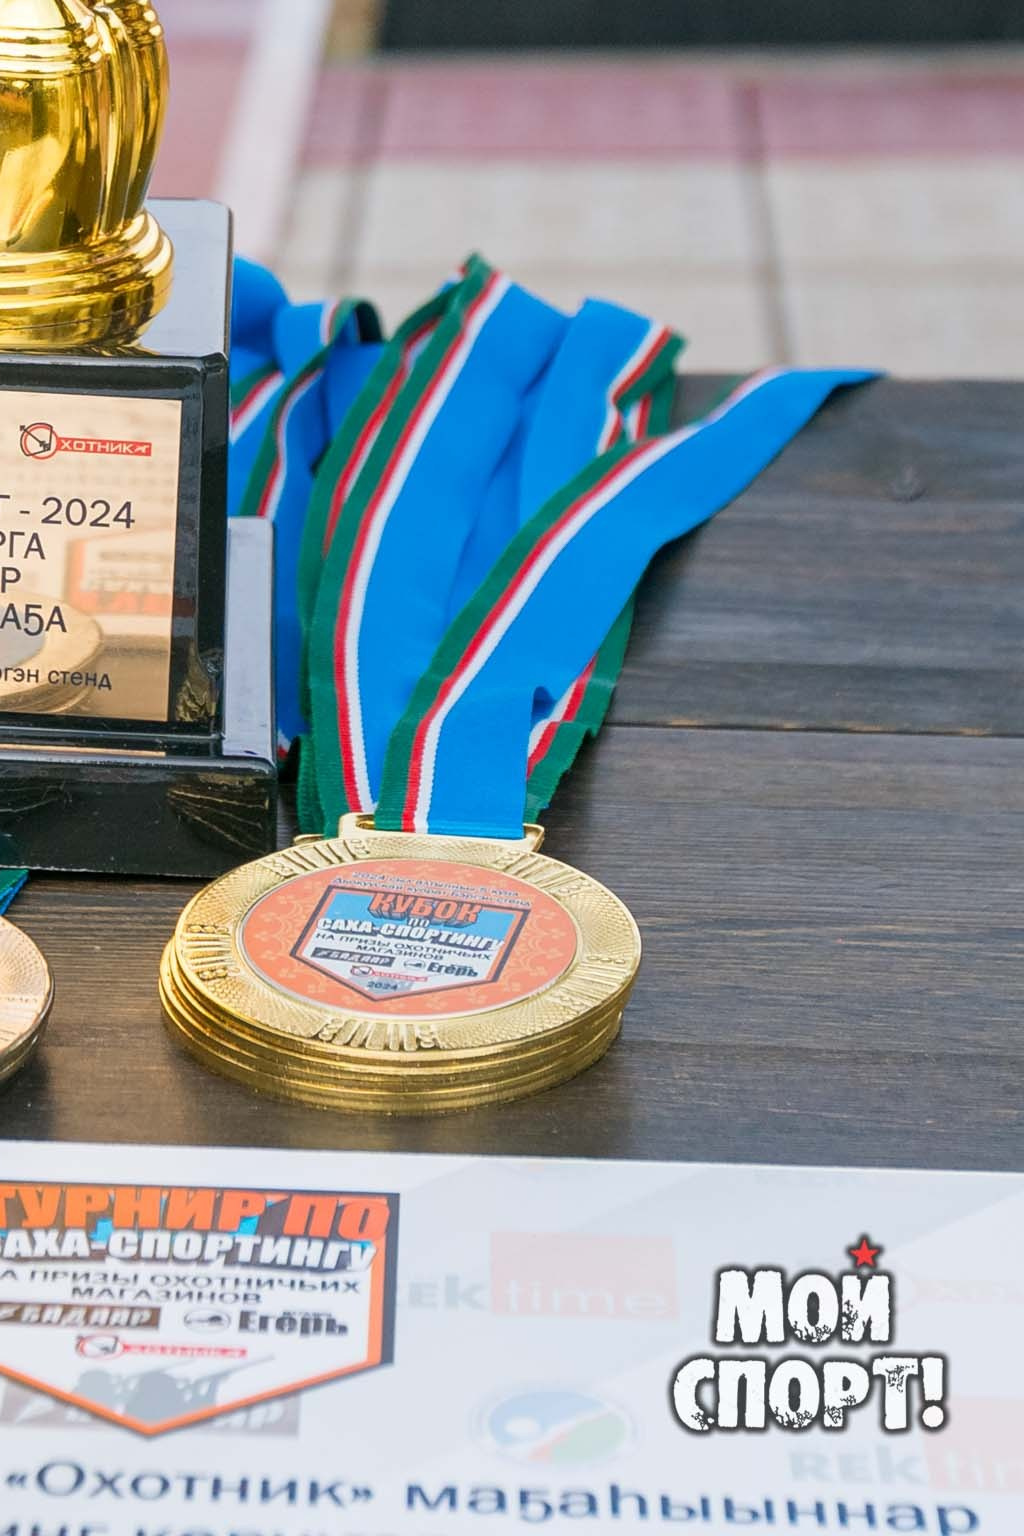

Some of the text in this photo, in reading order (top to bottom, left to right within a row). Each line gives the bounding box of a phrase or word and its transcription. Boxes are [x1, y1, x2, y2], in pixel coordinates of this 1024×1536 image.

[41, 497, 136, 529] 2024
[47, 668, 112, 690] стенд
[368, 891, 483, 923] КУБОК
[317, 917, 505, 951] САХА-СПОРТИНГУ
[282, 1193, 390, 1241] ПО
[29, 1269, 139, 1286] ПРИЗЫ
[149, 1273, 361, 1294] ОХОТНИЧЬИХ
[70, 1286, 262, 1305] МАГАЗИНОВ
[19, 1304, 153, 1328] БАДААР
[237, 1310, 349, 1337] Егерь
[4, 1460, 375, 1508] «Охотник»
